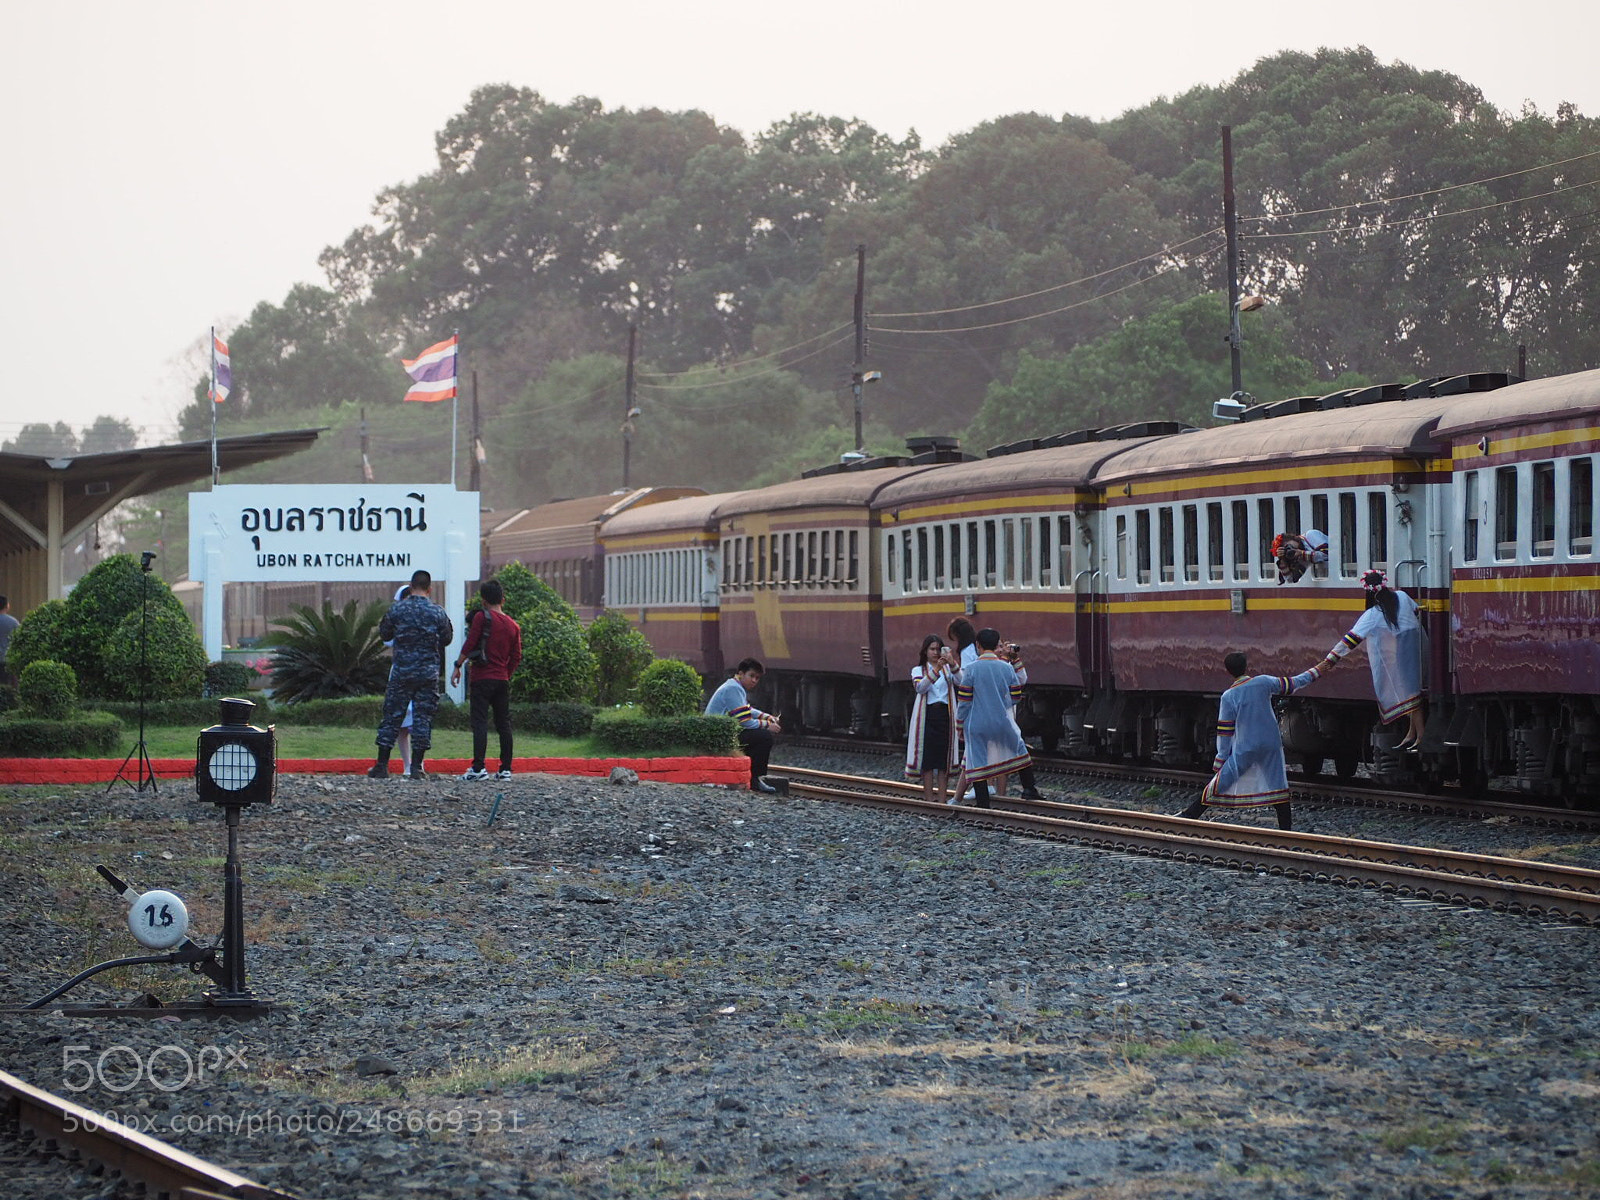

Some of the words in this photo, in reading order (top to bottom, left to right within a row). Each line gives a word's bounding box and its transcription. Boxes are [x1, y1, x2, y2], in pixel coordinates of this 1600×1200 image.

[241, 492, 427, 551] อุบลราชธานี
[257, 553, 297, 567] UBON
[303, 553, 411, 567] RATCHATHANI
[144, 904, 173, 927] 16
